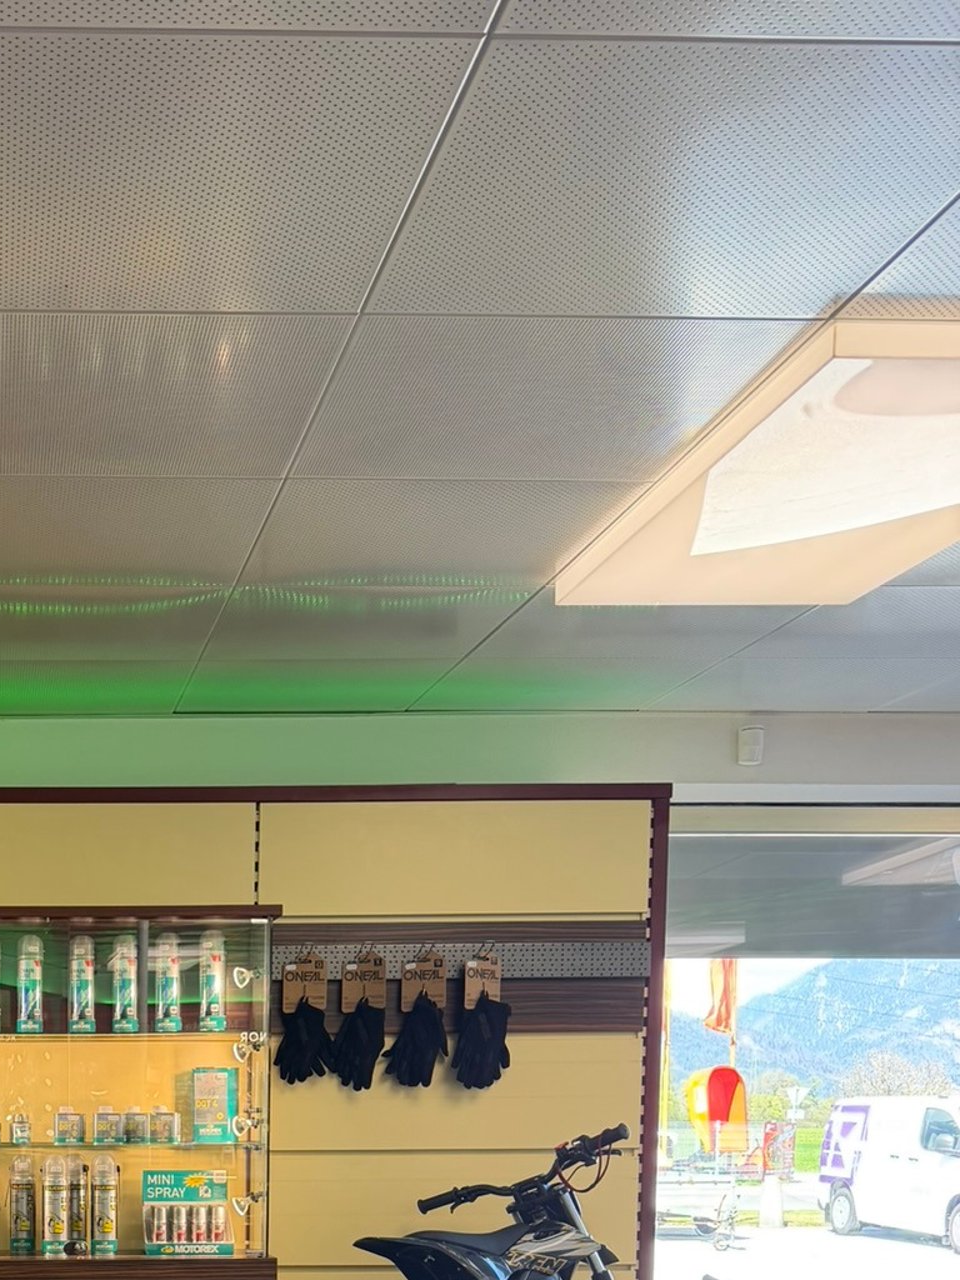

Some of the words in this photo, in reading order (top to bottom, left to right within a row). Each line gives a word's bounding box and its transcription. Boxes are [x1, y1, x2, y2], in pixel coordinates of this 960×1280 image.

[285, 971, 325, 982] ONEAL
[344, 970, 383, 982] ONEAL
[403, 969, 445, 981] ONEAL
[466, 967, 499, 980] ONEAL
[147, 1174, 174, 1185] MINI
[147, 1187, 186, 1198] SPRAY
[174, 1244, 220, 1253] MOTOREX
